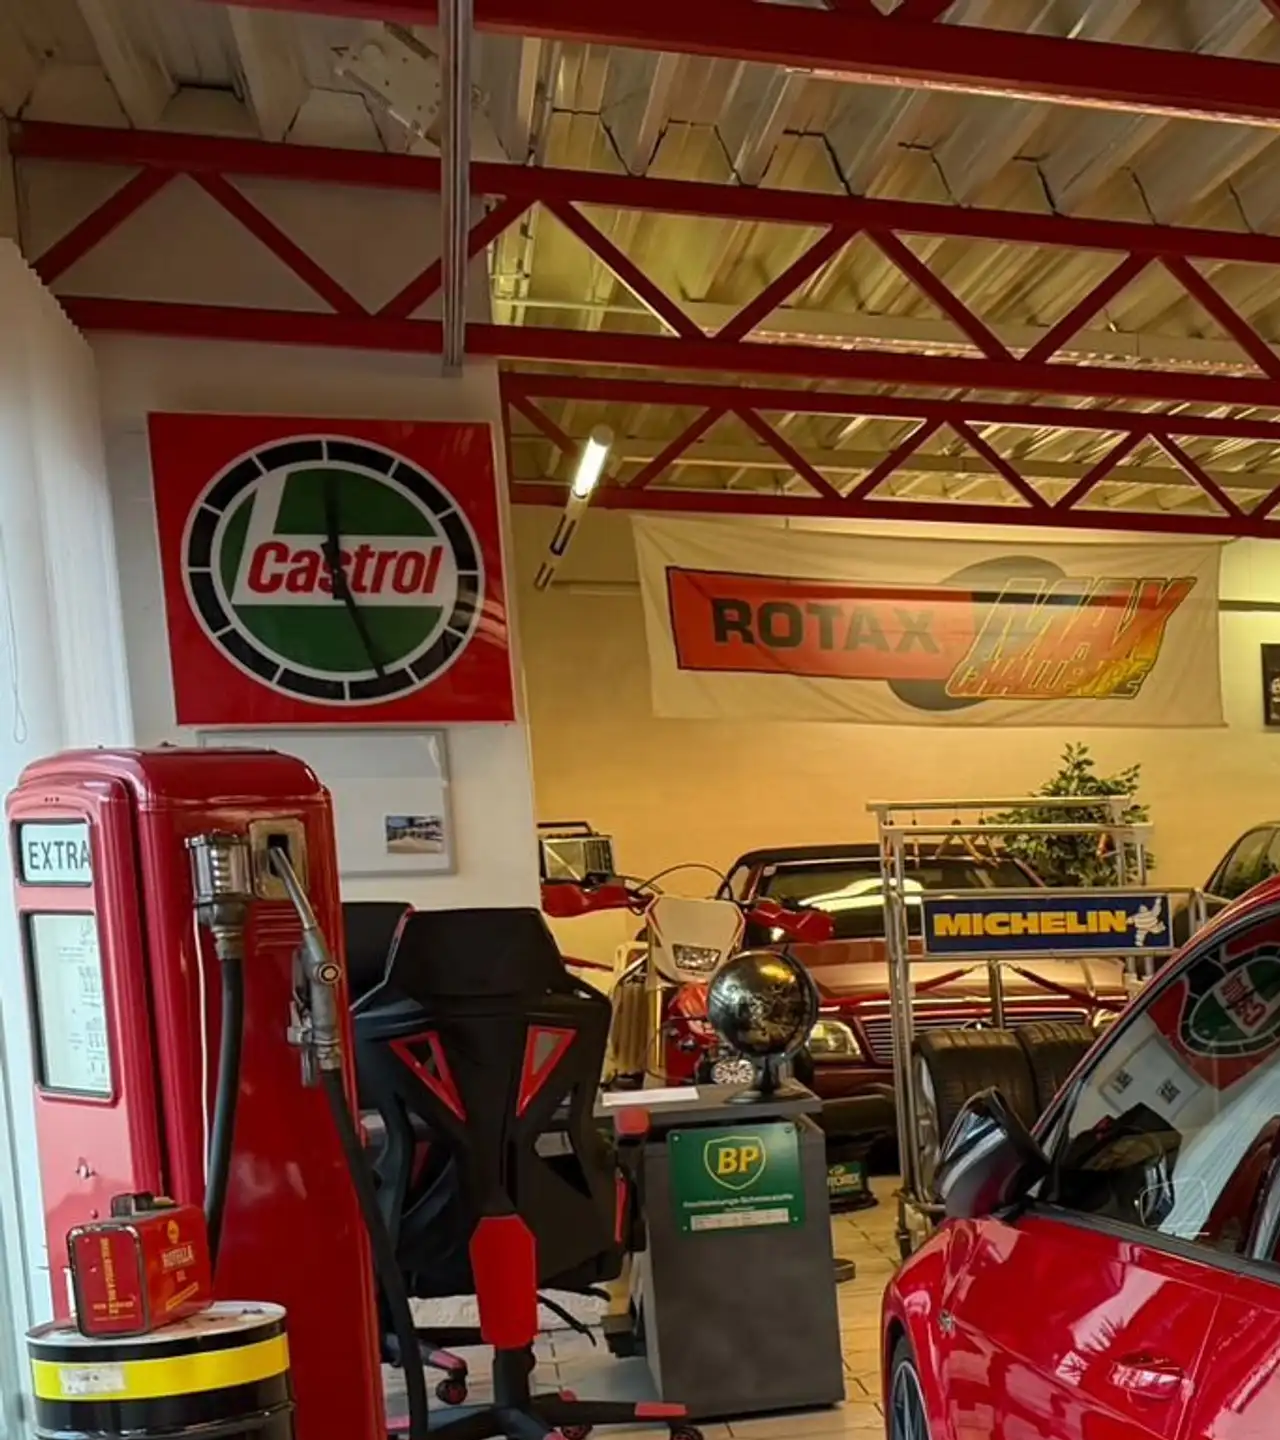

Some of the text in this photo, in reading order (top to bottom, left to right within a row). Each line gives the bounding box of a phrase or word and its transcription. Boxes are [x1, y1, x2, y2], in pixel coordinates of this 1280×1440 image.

[248, 541, 444, 594] Castrol
[712, 598, 940, 655] ROTAX
[28, 840, 91, 871] EXTRA
[933, 910, 1128, 937] MICHELIN
[718, 1146, 760, 1175] BP
